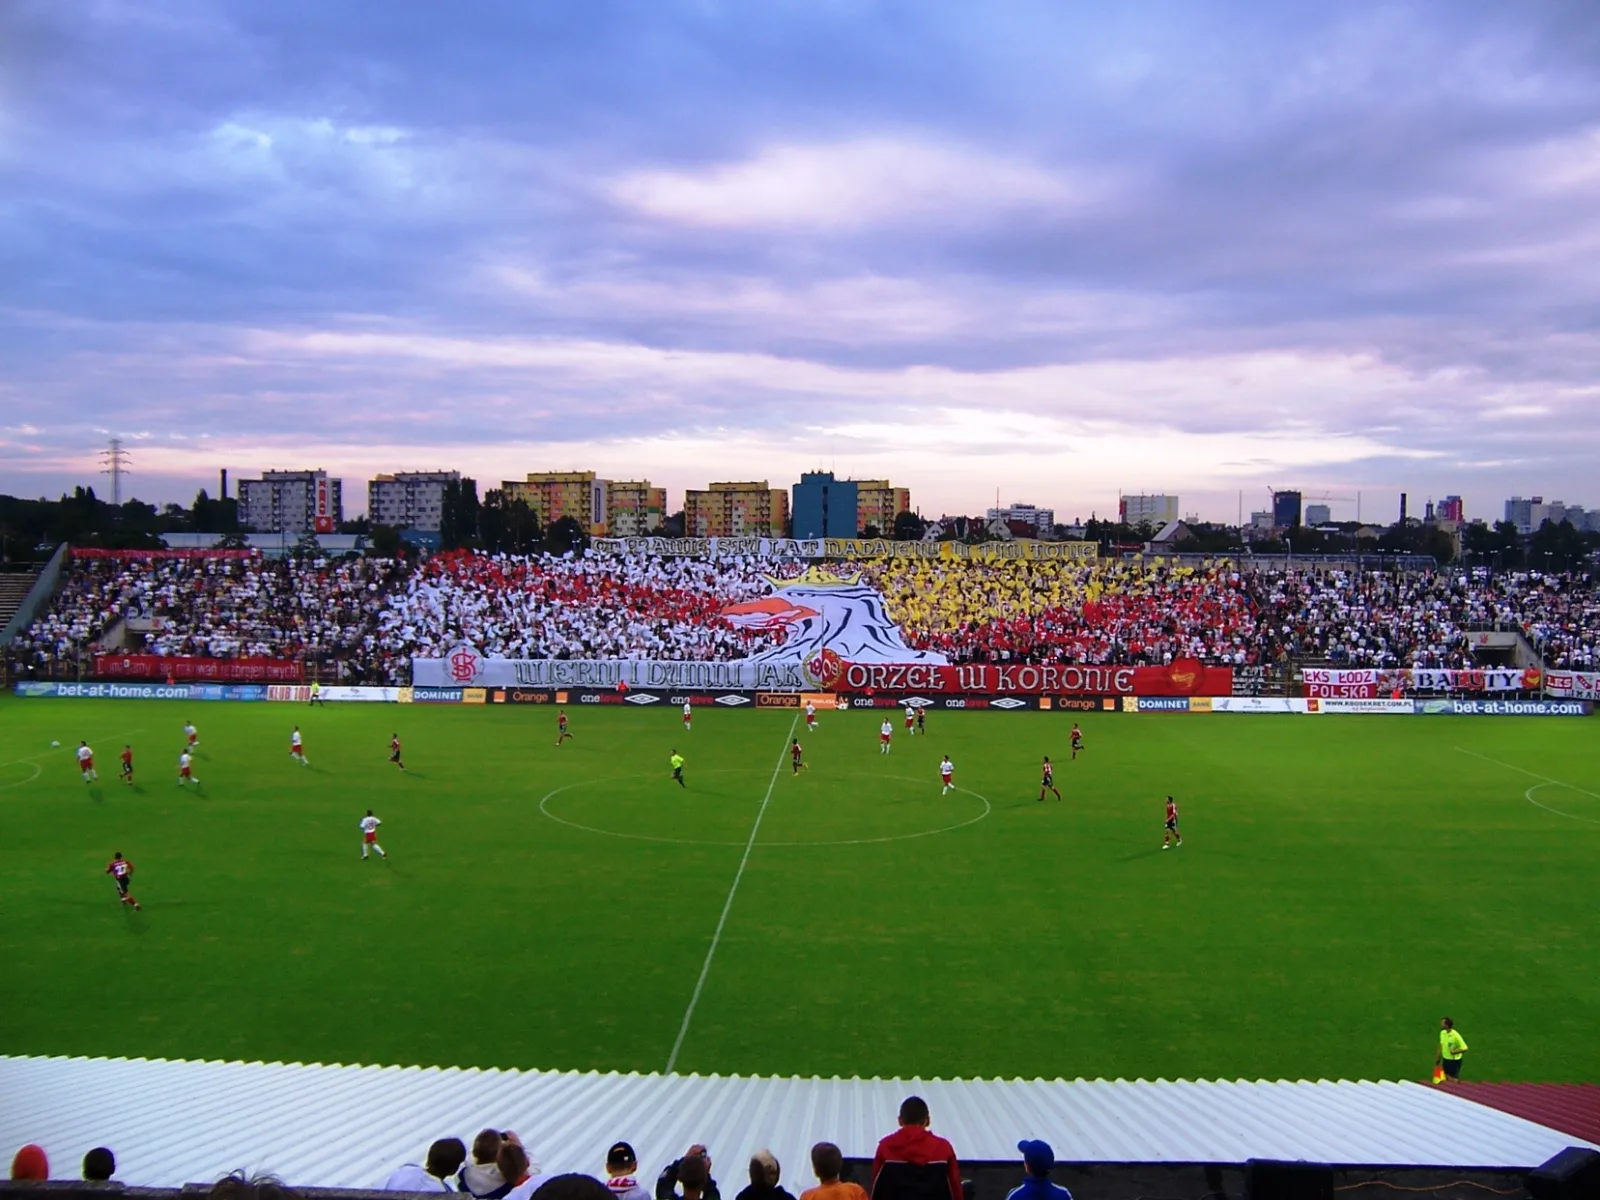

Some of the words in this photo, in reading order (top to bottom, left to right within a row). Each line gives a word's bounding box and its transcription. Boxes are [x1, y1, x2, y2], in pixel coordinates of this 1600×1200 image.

[768, 539, 819, 557] LAT
[1029, 543, 1096, 559] TONIE
[515, 660, 621, 686] WIERNI
[647, 662, 744, 688] DUMNI
[752, 662, 802, 688] JAK
[847, 664, 946, 690] ORZEŁ
[956, 666, 986, 690] W
[997, 665, 1135, 692] KORONIE
[57, 683, 188, 698] bet-at-home.com
[414, 691, 462, 701] DOMINET
[1309, 685, 1368, 698] POLSKA
[513, 691, 548, 704] Orange
[760, 694, 797, 706] Orange
[1058, 697, 1095, 710] Orange
[1139, 700, 1188, 709] DOMINET
[1453, 701, 1582, 714] bet-at-home.com
